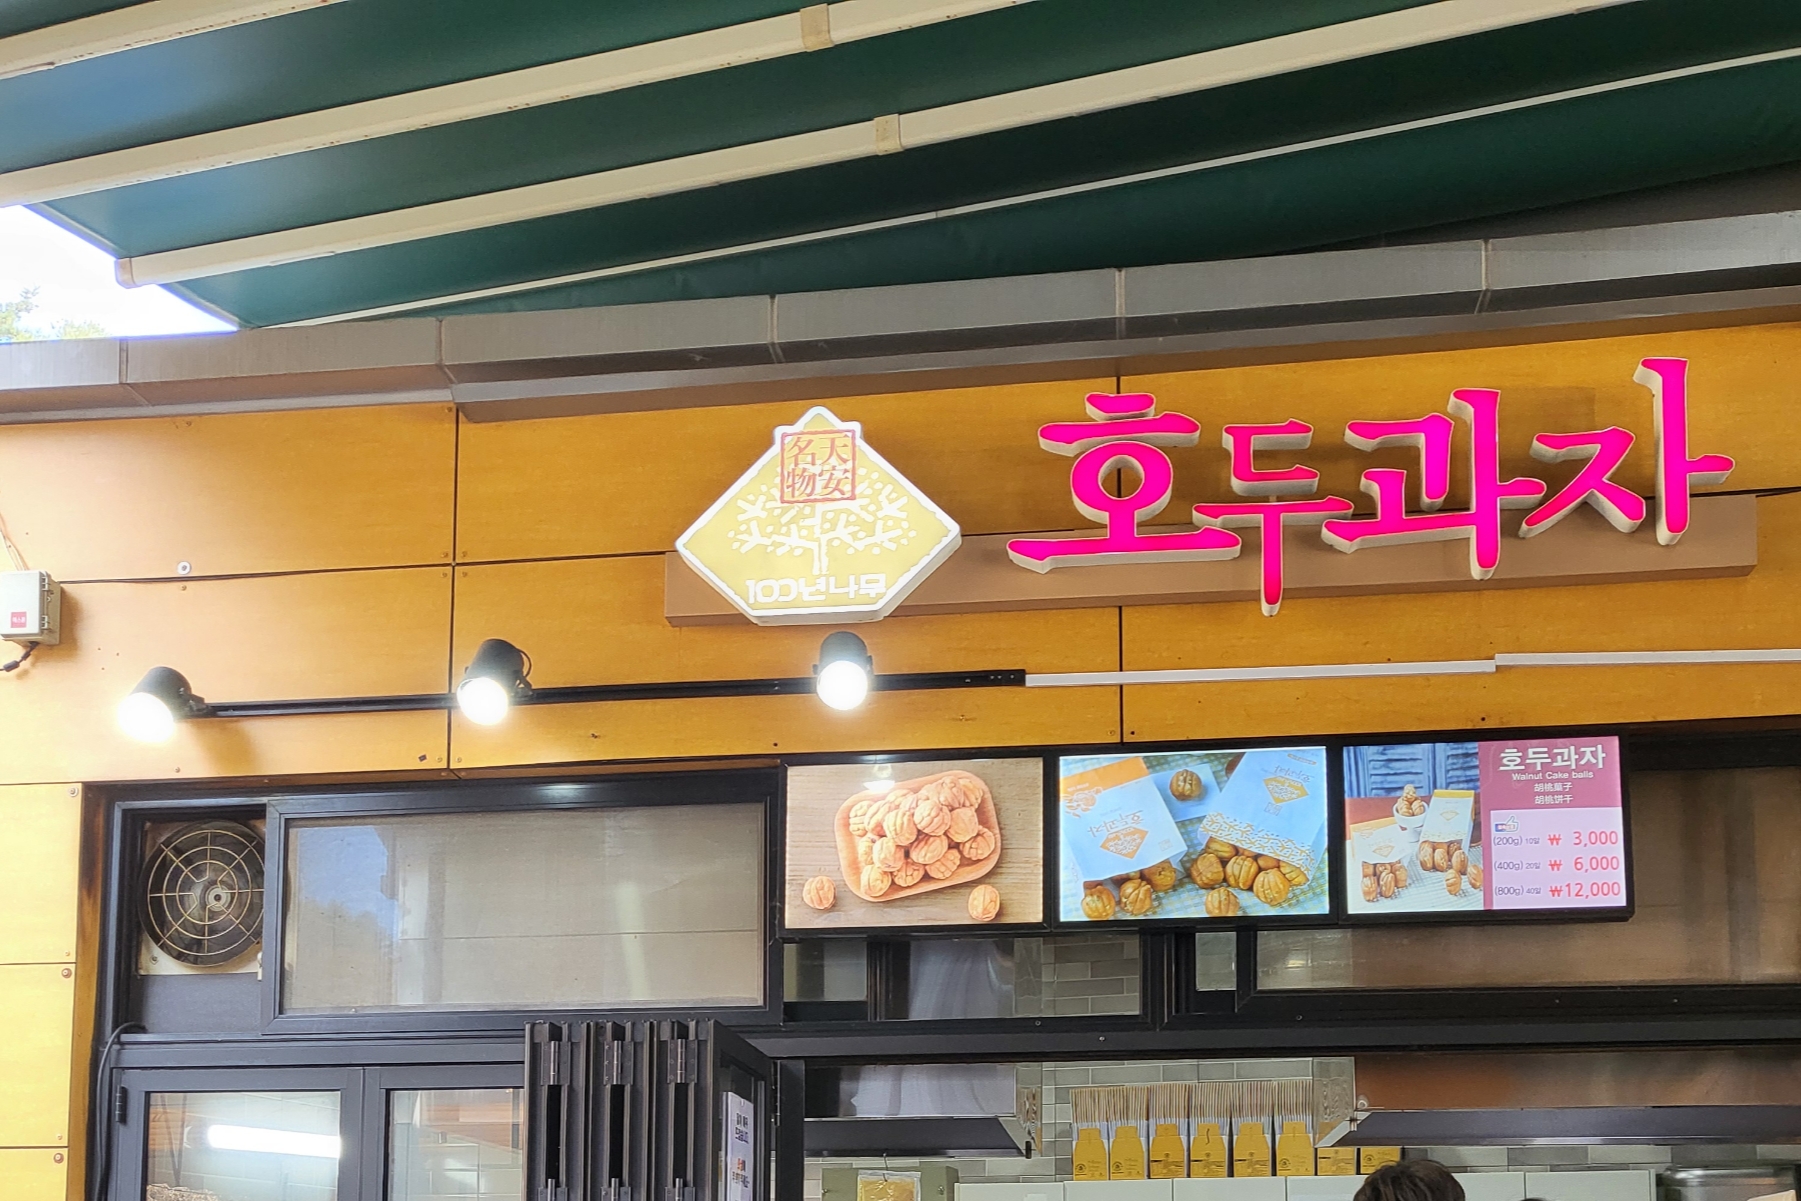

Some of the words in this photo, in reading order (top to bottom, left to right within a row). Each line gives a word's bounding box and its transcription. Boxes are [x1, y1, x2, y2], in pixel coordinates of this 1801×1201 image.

[1008, 357, 1736, 615] 호두과자
[1498, 744, 1606, 771] 호두과자
[1511, 772, 1543, 781] Walnut
[1545, 771, 1569, 780] Cake
[1571, 770, 1594, 779] balls
[1493, 835, 1523, 847] (200g)
[1572, 830, 1619, 848] 3,000
[1493, 860, 1524, 872] (400g)
[1573, 855, 1620, 873] 6,000
[1494, 885, 1524, 897] (800g)
